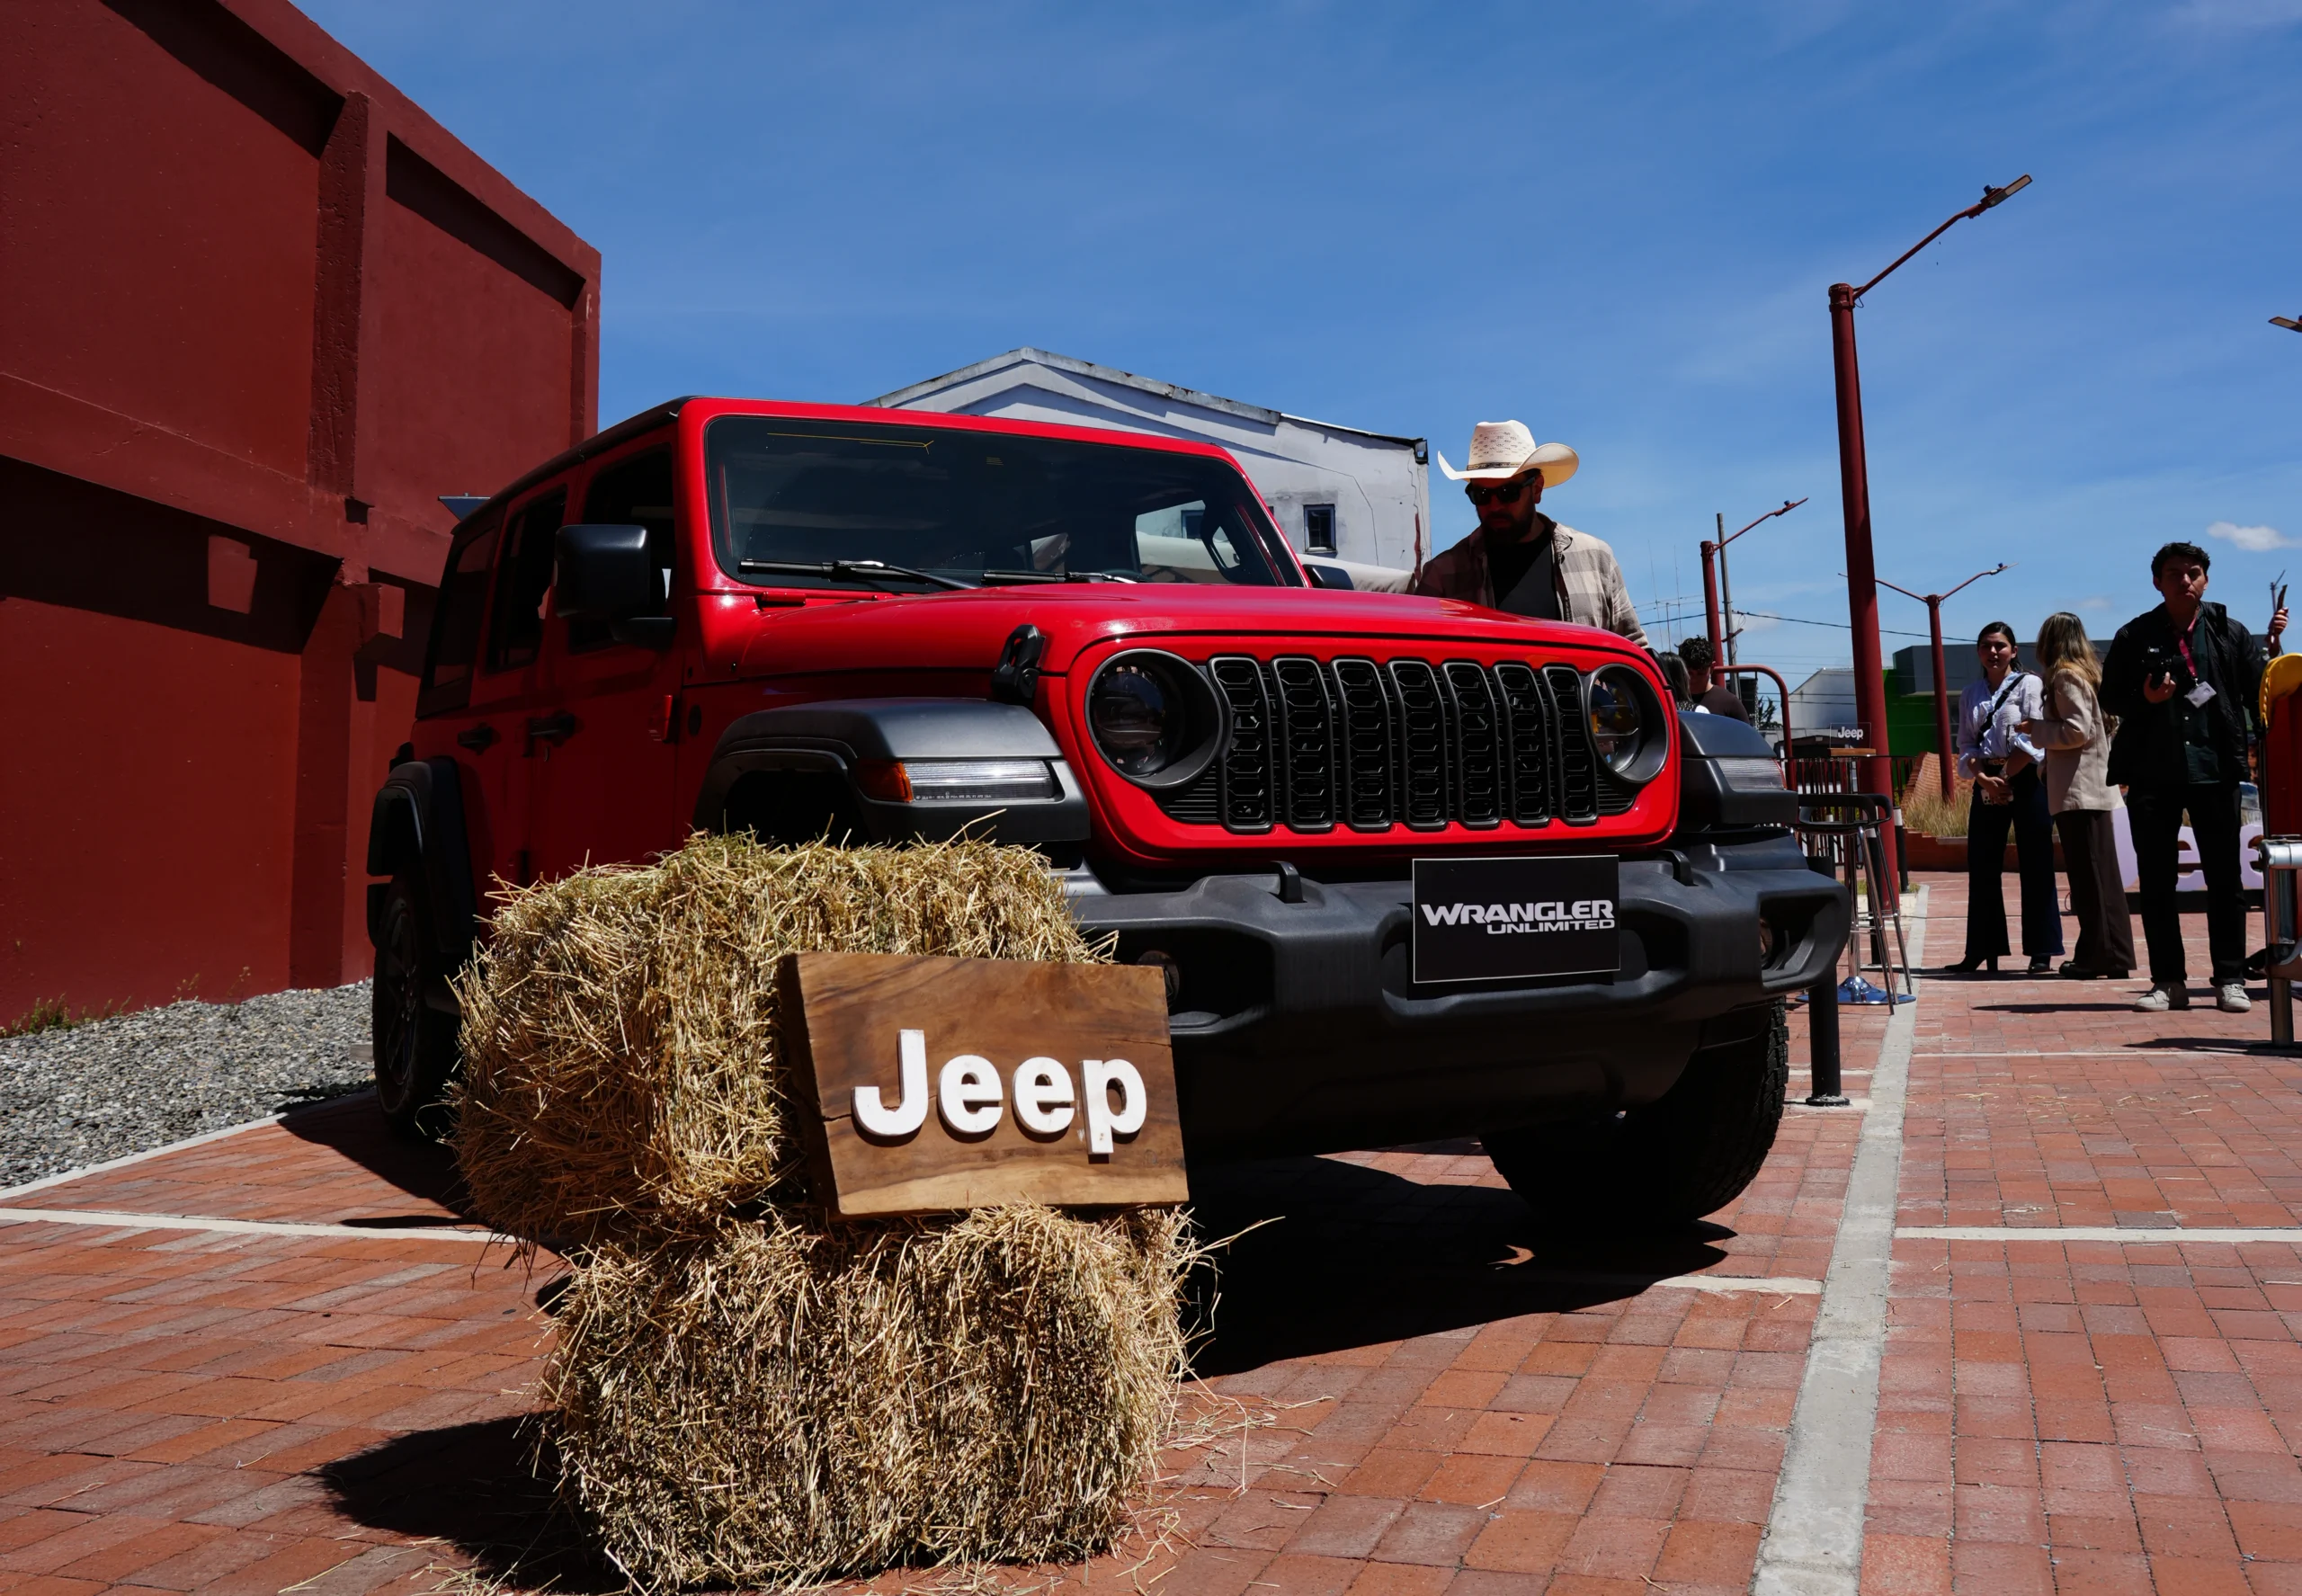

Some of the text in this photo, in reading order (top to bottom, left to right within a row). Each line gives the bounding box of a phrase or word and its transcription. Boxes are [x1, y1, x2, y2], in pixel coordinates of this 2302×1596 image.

[1838, 727, 1863, 740] Jeep
[1421, 900, 1615, 926] WRANGLER
[1486, 919, 1615, 935] UNLIMITED
[851, 1029, 1147, 1155] Jeep
